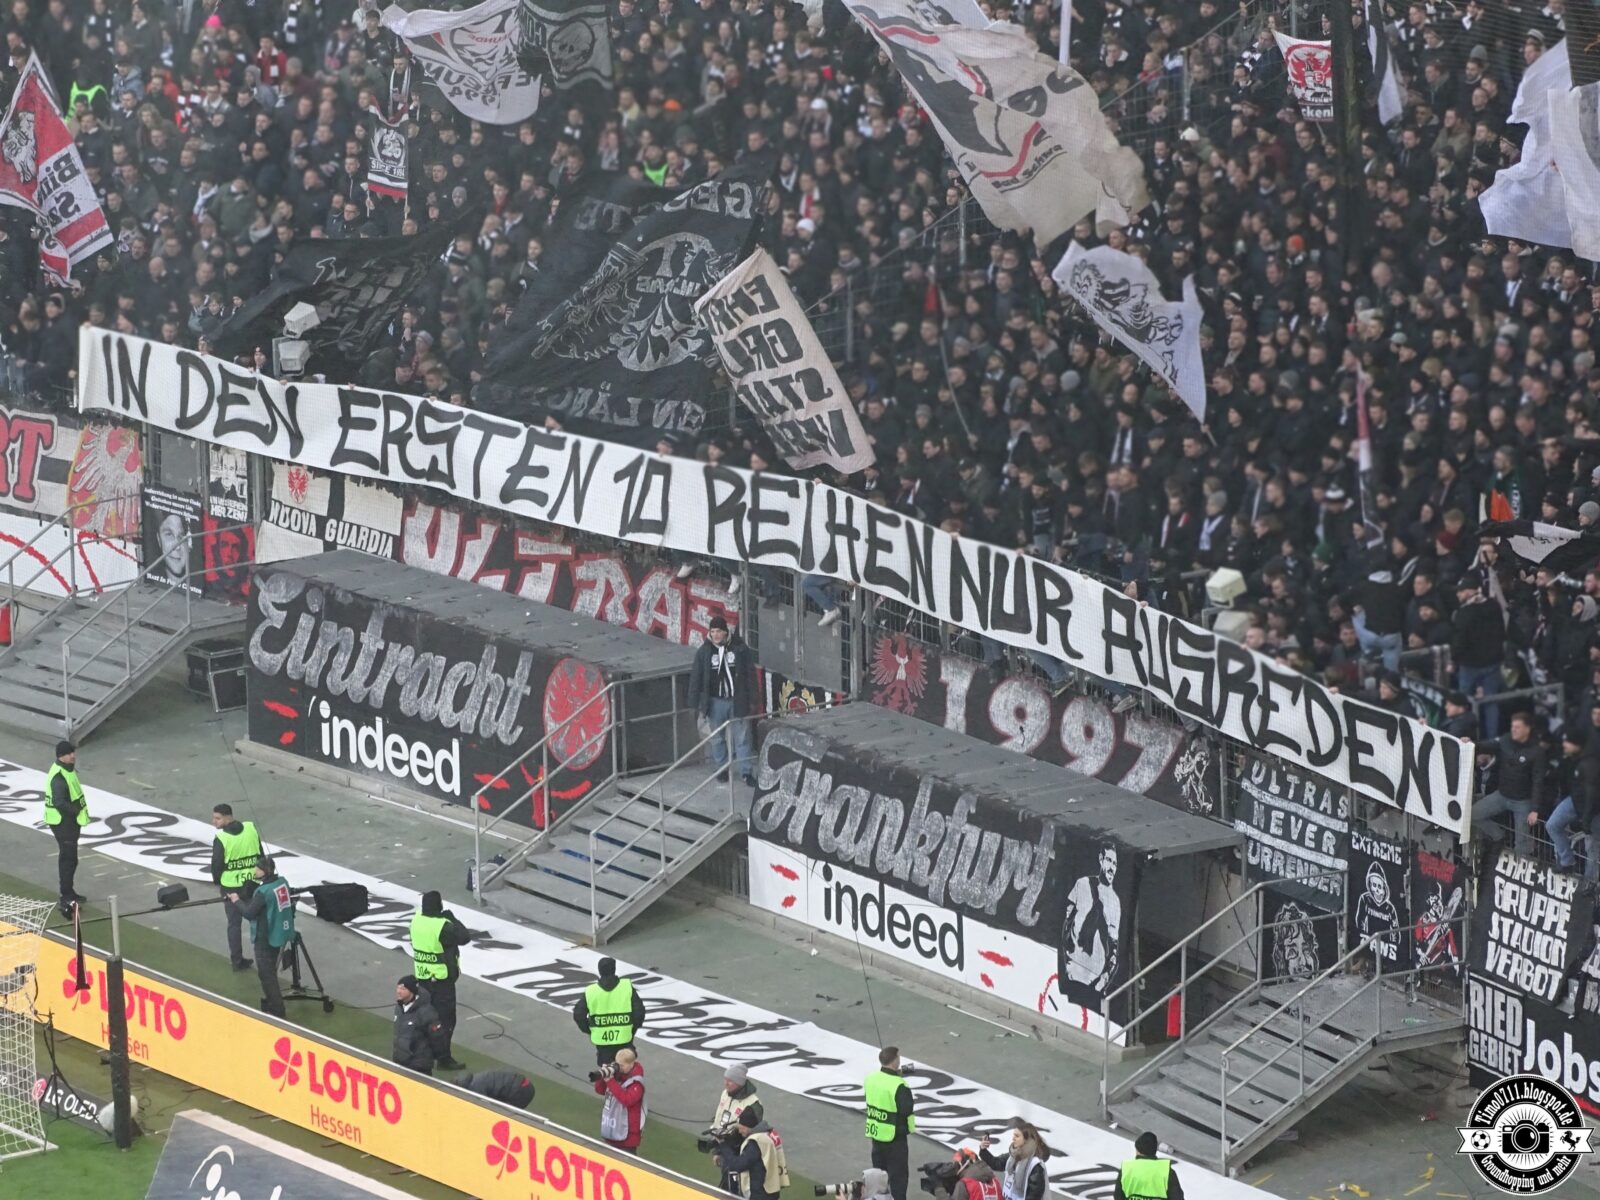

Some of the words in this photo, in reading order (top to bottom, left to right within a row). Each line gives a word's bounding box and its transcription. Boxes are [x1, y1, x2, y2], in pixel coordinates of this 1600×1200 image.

[269, 500, 317, 536] NUOVA
[324, 518, 393, 560] GUARDIA
[103, 334, 151, 418] IN
[175, 350, 304, 459] DEN
[330, 387, 604, 525] ERSTEN
[614, 452, 672, 538] 10
[703, 465, 936, 613] REIHEN
[949, 539, 1083, 660] NUR
[1101, 586, 1462, 822] AUSREDEN!
[249, 573, 534, 746] Eintracht
[308, 695, 461, 796] indeed
[939, 653, 1184, 795] 1997
[1252, 760, 1349, 819] ULTRAS
[752, 727, 1056, 928] Frankfurt
[1252, 801, 1337, 856] NEVER
[1351, 831, 1401, 865] EXTREME
[228, 857, 257, 870] STEWAR
[1235, 839, 1343, 897] URRENDER
[1495, 852, 1536, 886] EHRE
[1546, 867, 1579, 901] DER
[811, 860, 965, 973] indeed
[1494, 875, 1571, 939] GRUPPE
[1488, 912, 1567, 969] STADION
[1485, 941, 1562, 1002] VERBOT
[594, 1015, 630, 1026] STEWARD
[601, 1029, 620, 1042] 407
[1469, 980, 1523, 1047] RIED
[1469, 1029, 1522, 1077] GEBIET
[45, 1086, 64, 1106] LG
[308, 1051, 402, 1125] LOTTO
[867, 1106, 888, 1121] WARD
[310, 1104, 362, 1144] Hessen
[527, 1136, 632, 1200] LOTTO
